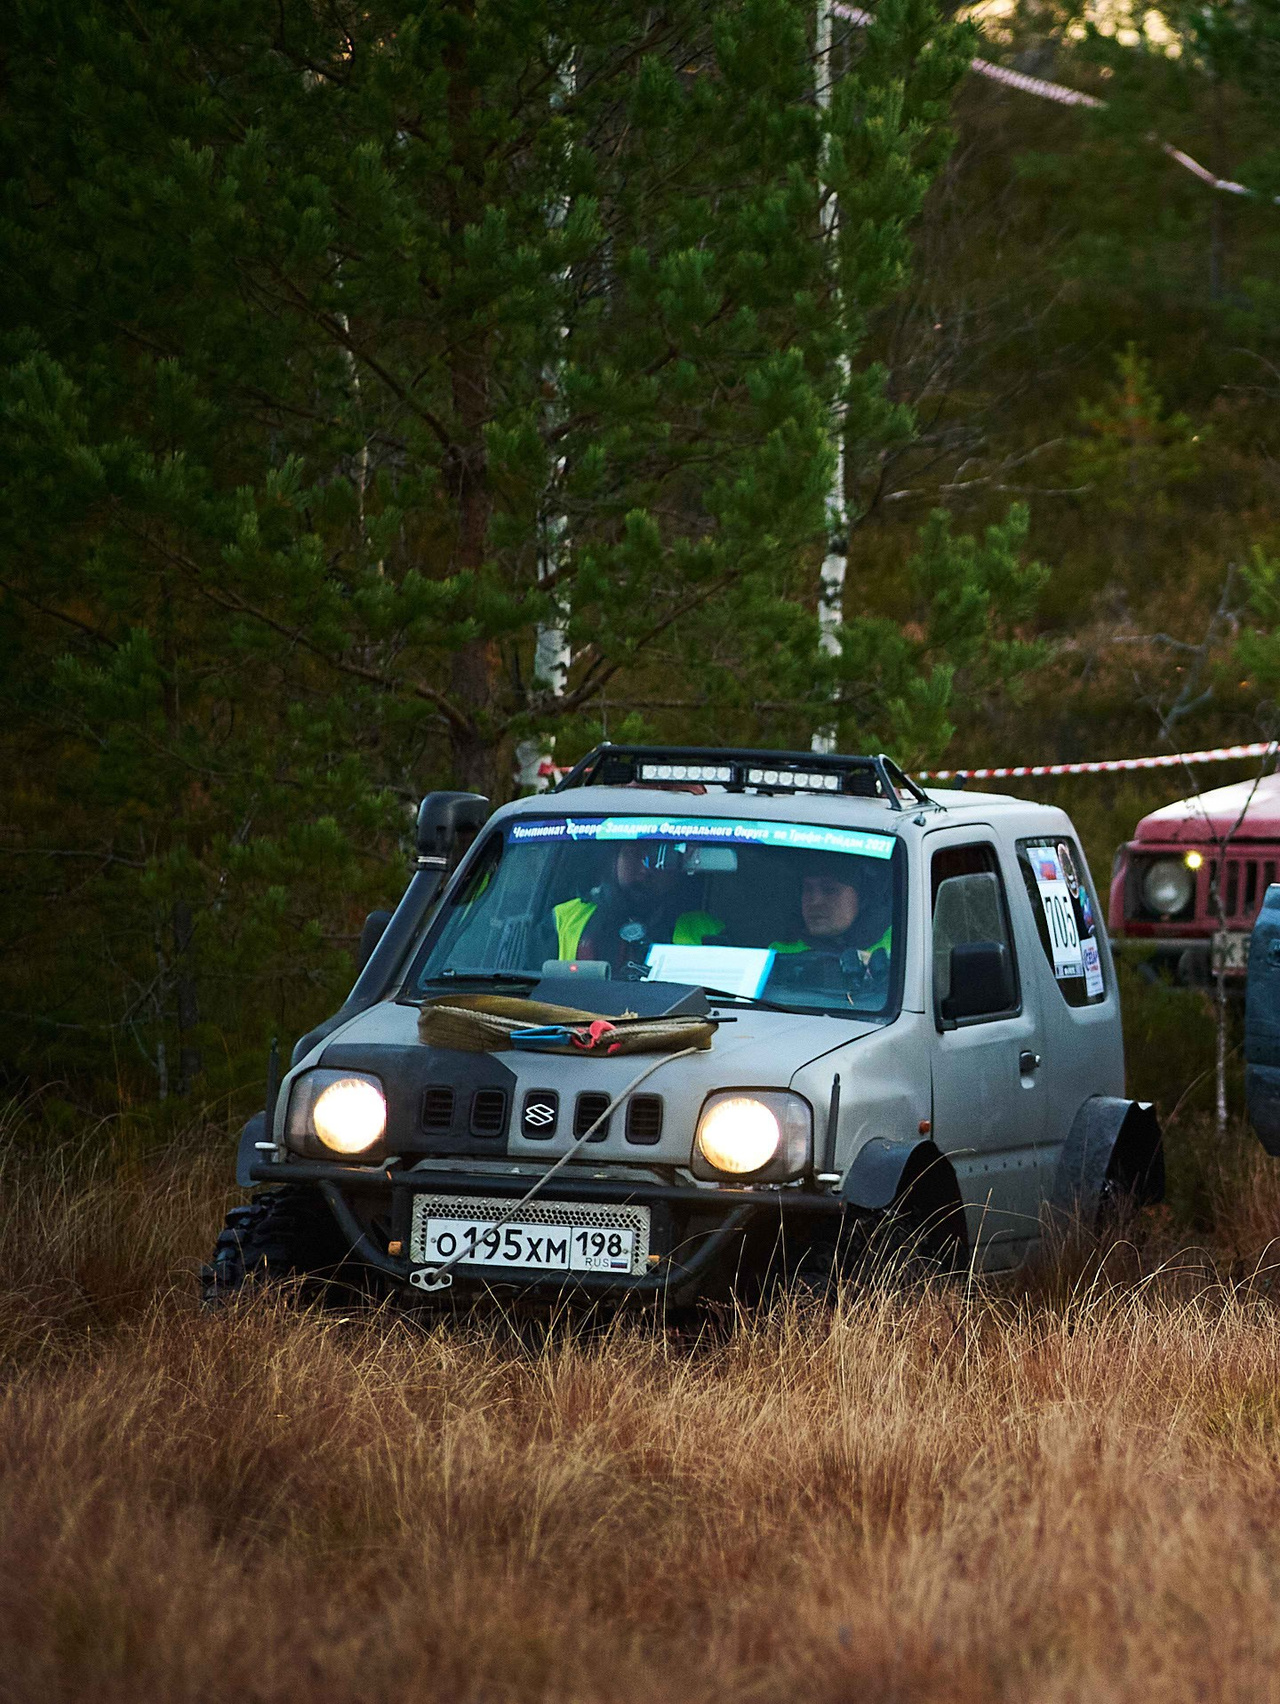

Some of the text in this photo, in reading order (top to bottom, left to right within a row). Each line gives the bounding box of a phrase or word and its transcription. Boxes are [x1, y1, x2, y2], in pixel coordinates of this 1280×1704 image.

[513, 825, 566, 838] Чемпионат
[660, 822, 732, 836] Федерального
[734, 825, 769, 839] Округа
[1044, 896, 1077, 948] 705
[575, 1231, 622, 1258] 198
[585, 1257, 610, 1268] RUS
